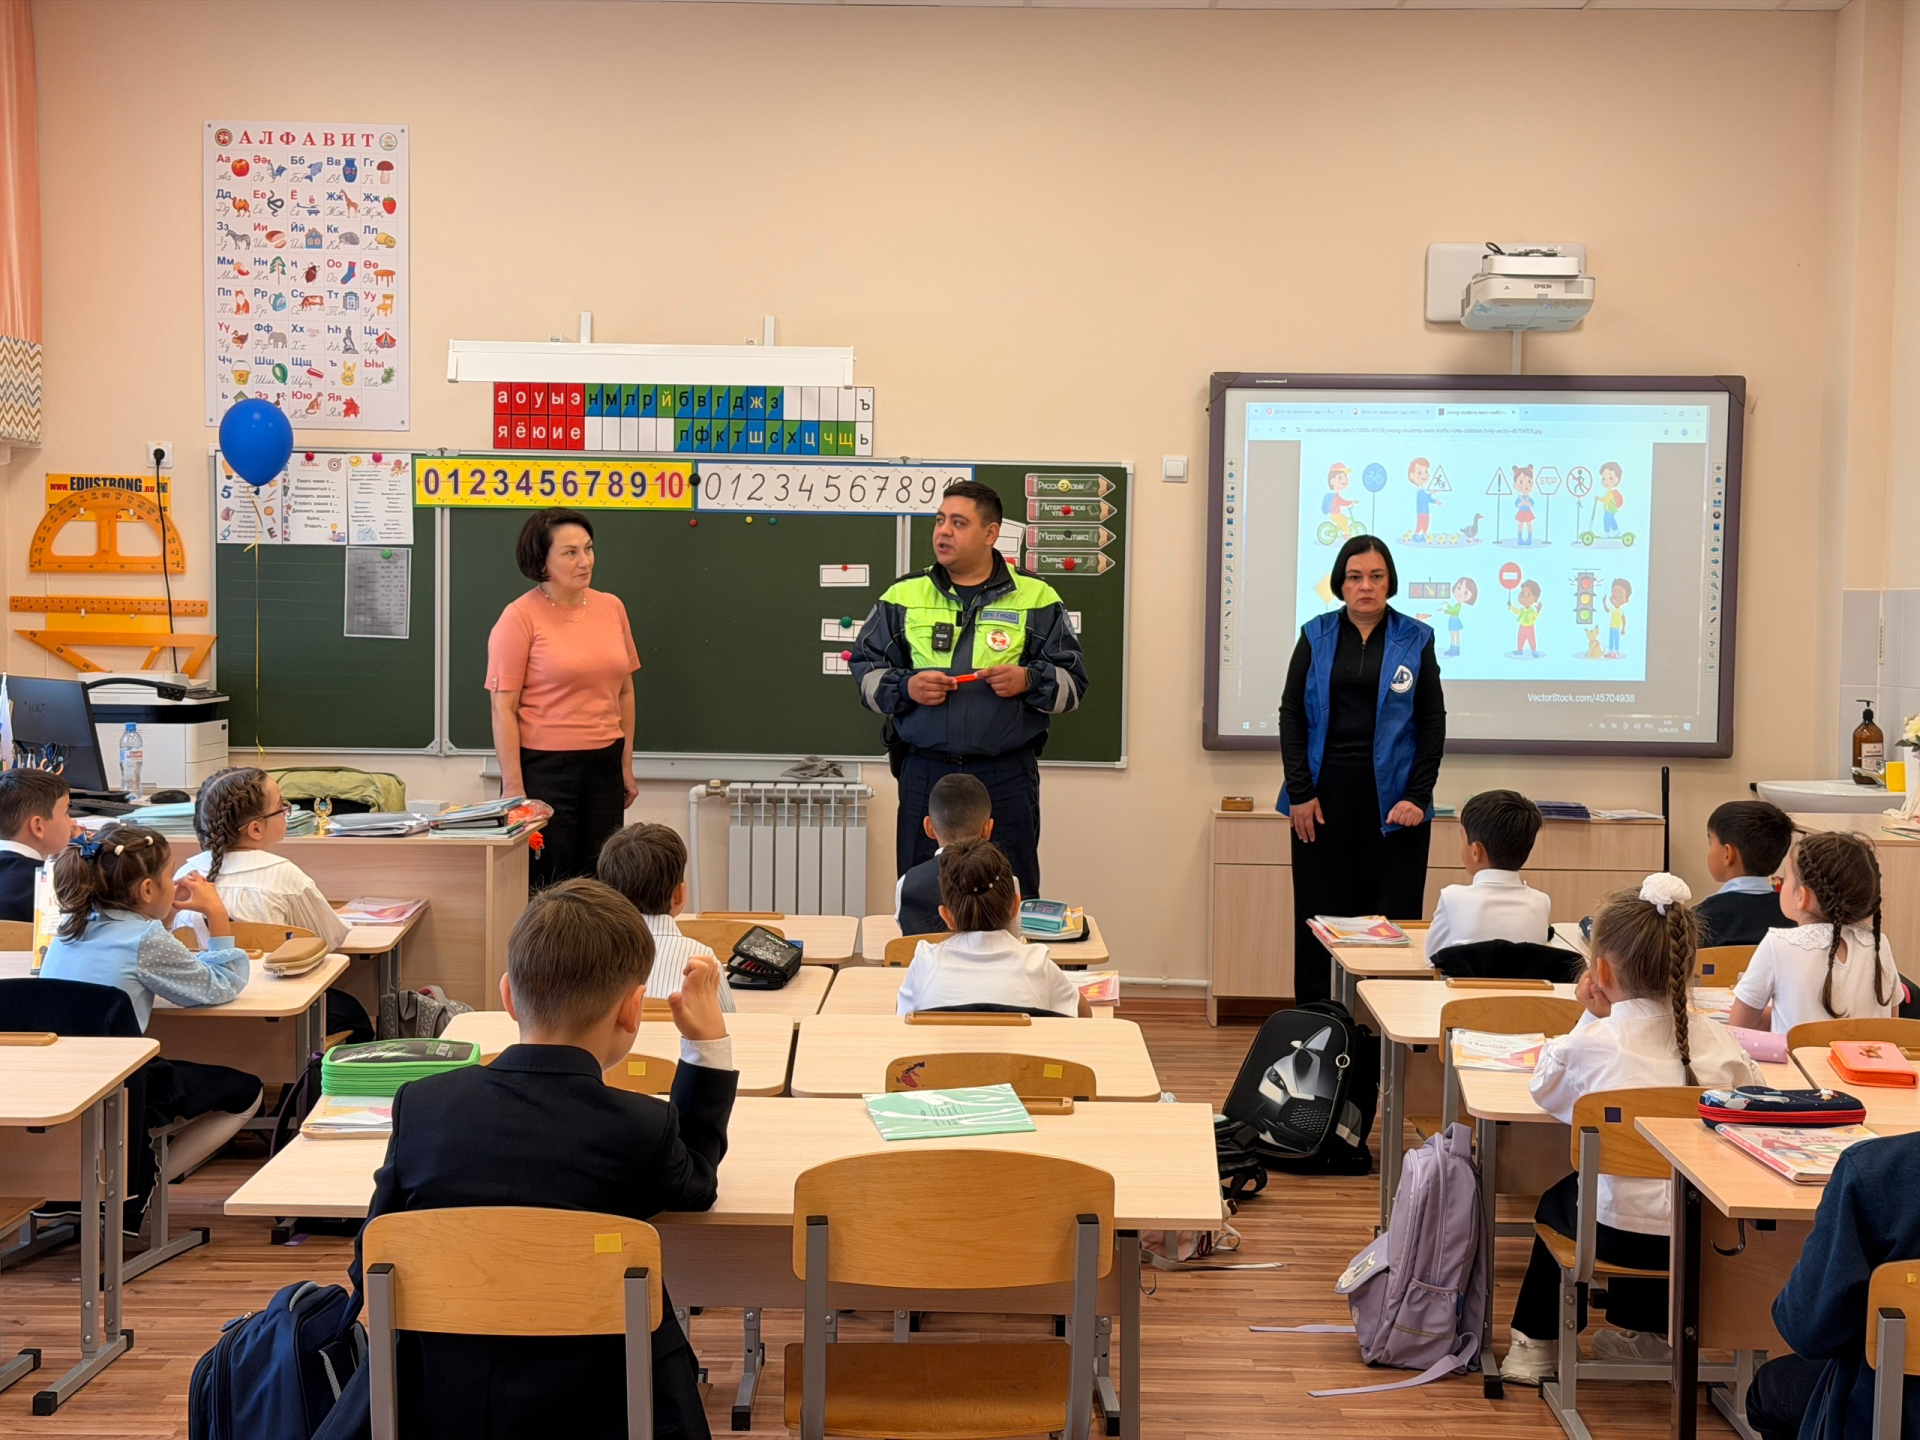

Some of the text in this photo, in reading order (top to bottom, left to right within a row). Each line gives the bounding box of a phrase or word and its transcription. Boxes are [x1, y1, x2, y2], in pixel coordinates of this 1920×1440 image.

[238, 130, 374, 148] АЛФАВИТ
[216, 154, 374, 167] Аа Әә Бб Вв Гг
[216, 221, 378, 234] Зз Ии Йй Кк Лл
[217, 287, 377, 302] Пп Рр Сс Тт Уу
[498, 390, 870, 411] а о у ы э н м л р й б в г д ж з ъ
[498, 422, 869, 448] я ё ю и е п ф к т ш с х ц ч щ ь
[70, 477, 142, 492] EDUSTRONG
[424, 468, 684, 498] 0 1 2 3 4 5 6 7 8 9 10
[1540, 476, 1557, 485] STOP
[1528, 693, 1635, 703] VectorStock.com/45704938
